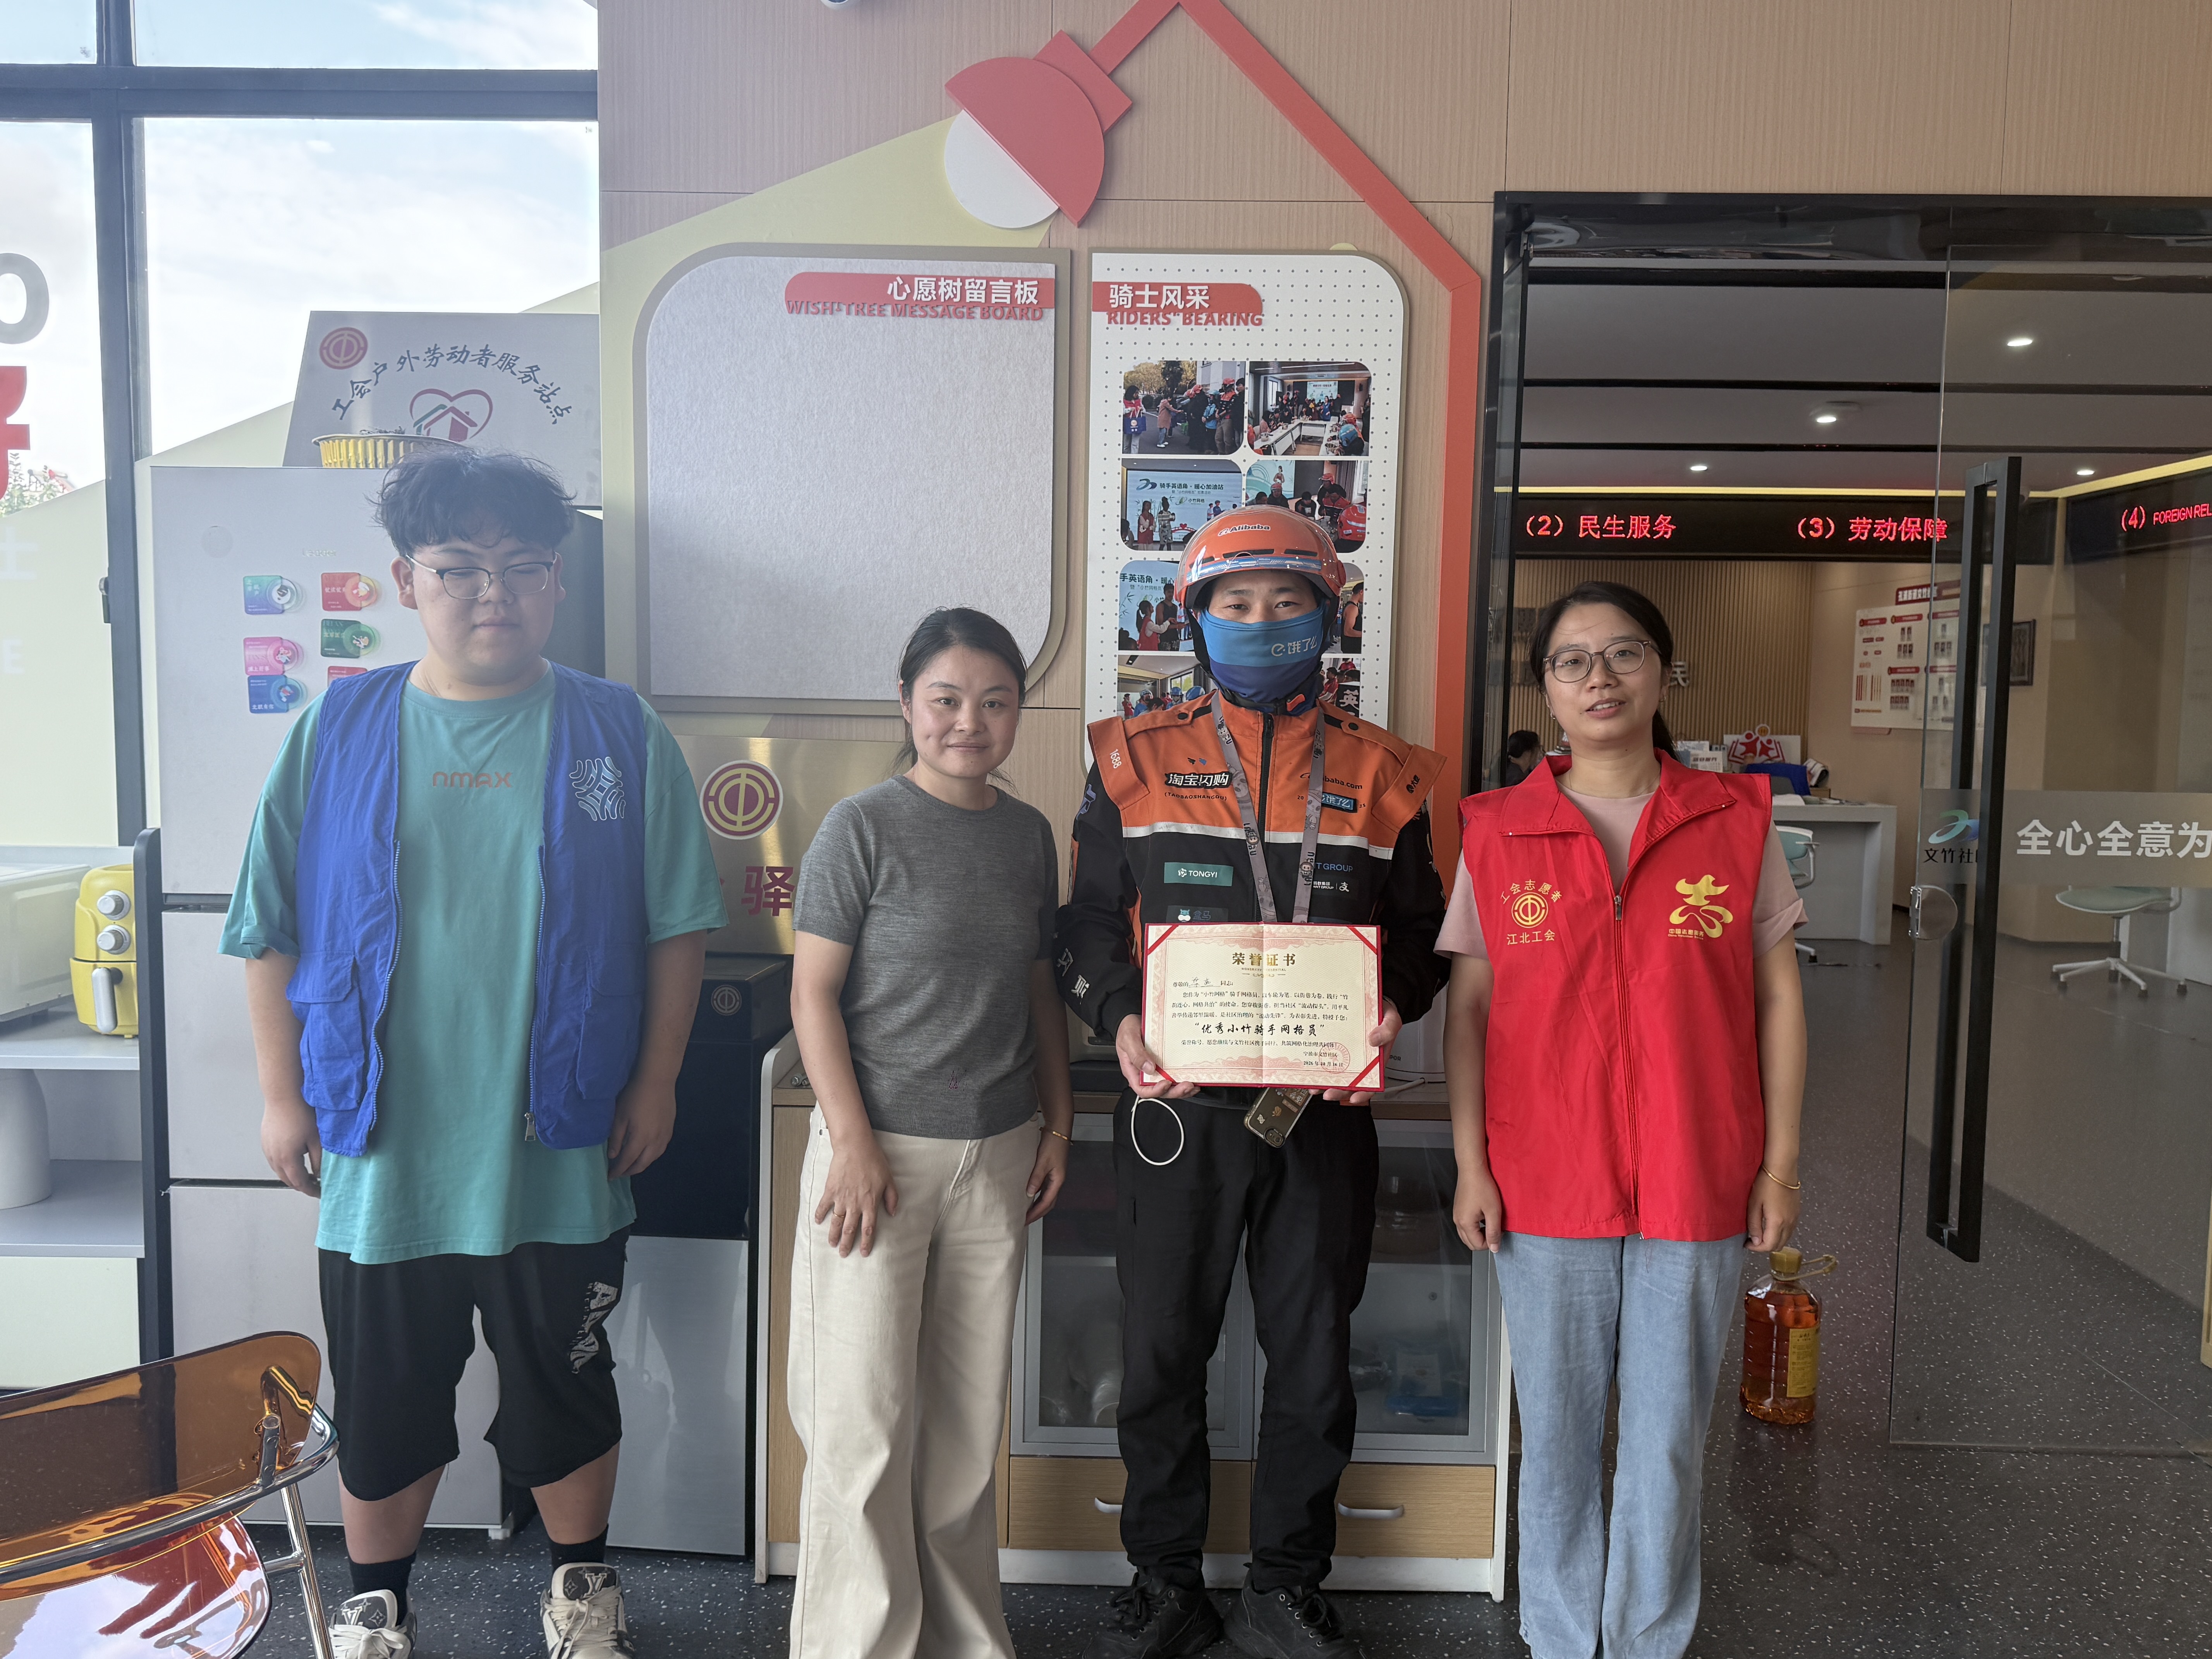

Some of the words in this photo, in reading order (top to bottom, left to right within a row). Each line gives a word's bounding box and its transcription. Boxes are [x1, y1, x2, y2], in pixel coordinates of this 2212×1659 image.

[887, 275, 1038, 305] 心愿树留言板
[1109, 284, 1209, 309] 骑士风采
[891, 302, 975, 319] MESSAGE
[979, 305, 1044, 321] BOARD
[1182, 313, 1263, 326] BEARING
[331, 343, 572, 425] 工会户外劳动者服务站点
[2153, 507, 2192, 525] FOREIGN
[2193, 503, 2212, 518] REL
[1230, 524, 1271, 534] Alibaba
[1578, 514, 1676, 539] 民生服务
[1848, 517, 1948, 541] 劳动保障
[1109, 749, 1122, 769] 1688
[1168, 772, 1230, 786] 淘宝闪购
[2016, 819, 2212, 859] 全心全意为
[1923, 848, 1978, 864] 文竹社
[1188, 870, 1218, 878] TONGYI
[1323, 863, 1353, 872] GROUP
[741, 866, 795, 916] 驿
[1499, 879, 1562, 905] 工会志愿者
[1506, 929, 1556, 946] 江北工会
[1232, 952, 1296, 966] 荣誉证书
[1195, 1022, 1324, 1037] “优秀小竹骑手网格员”
